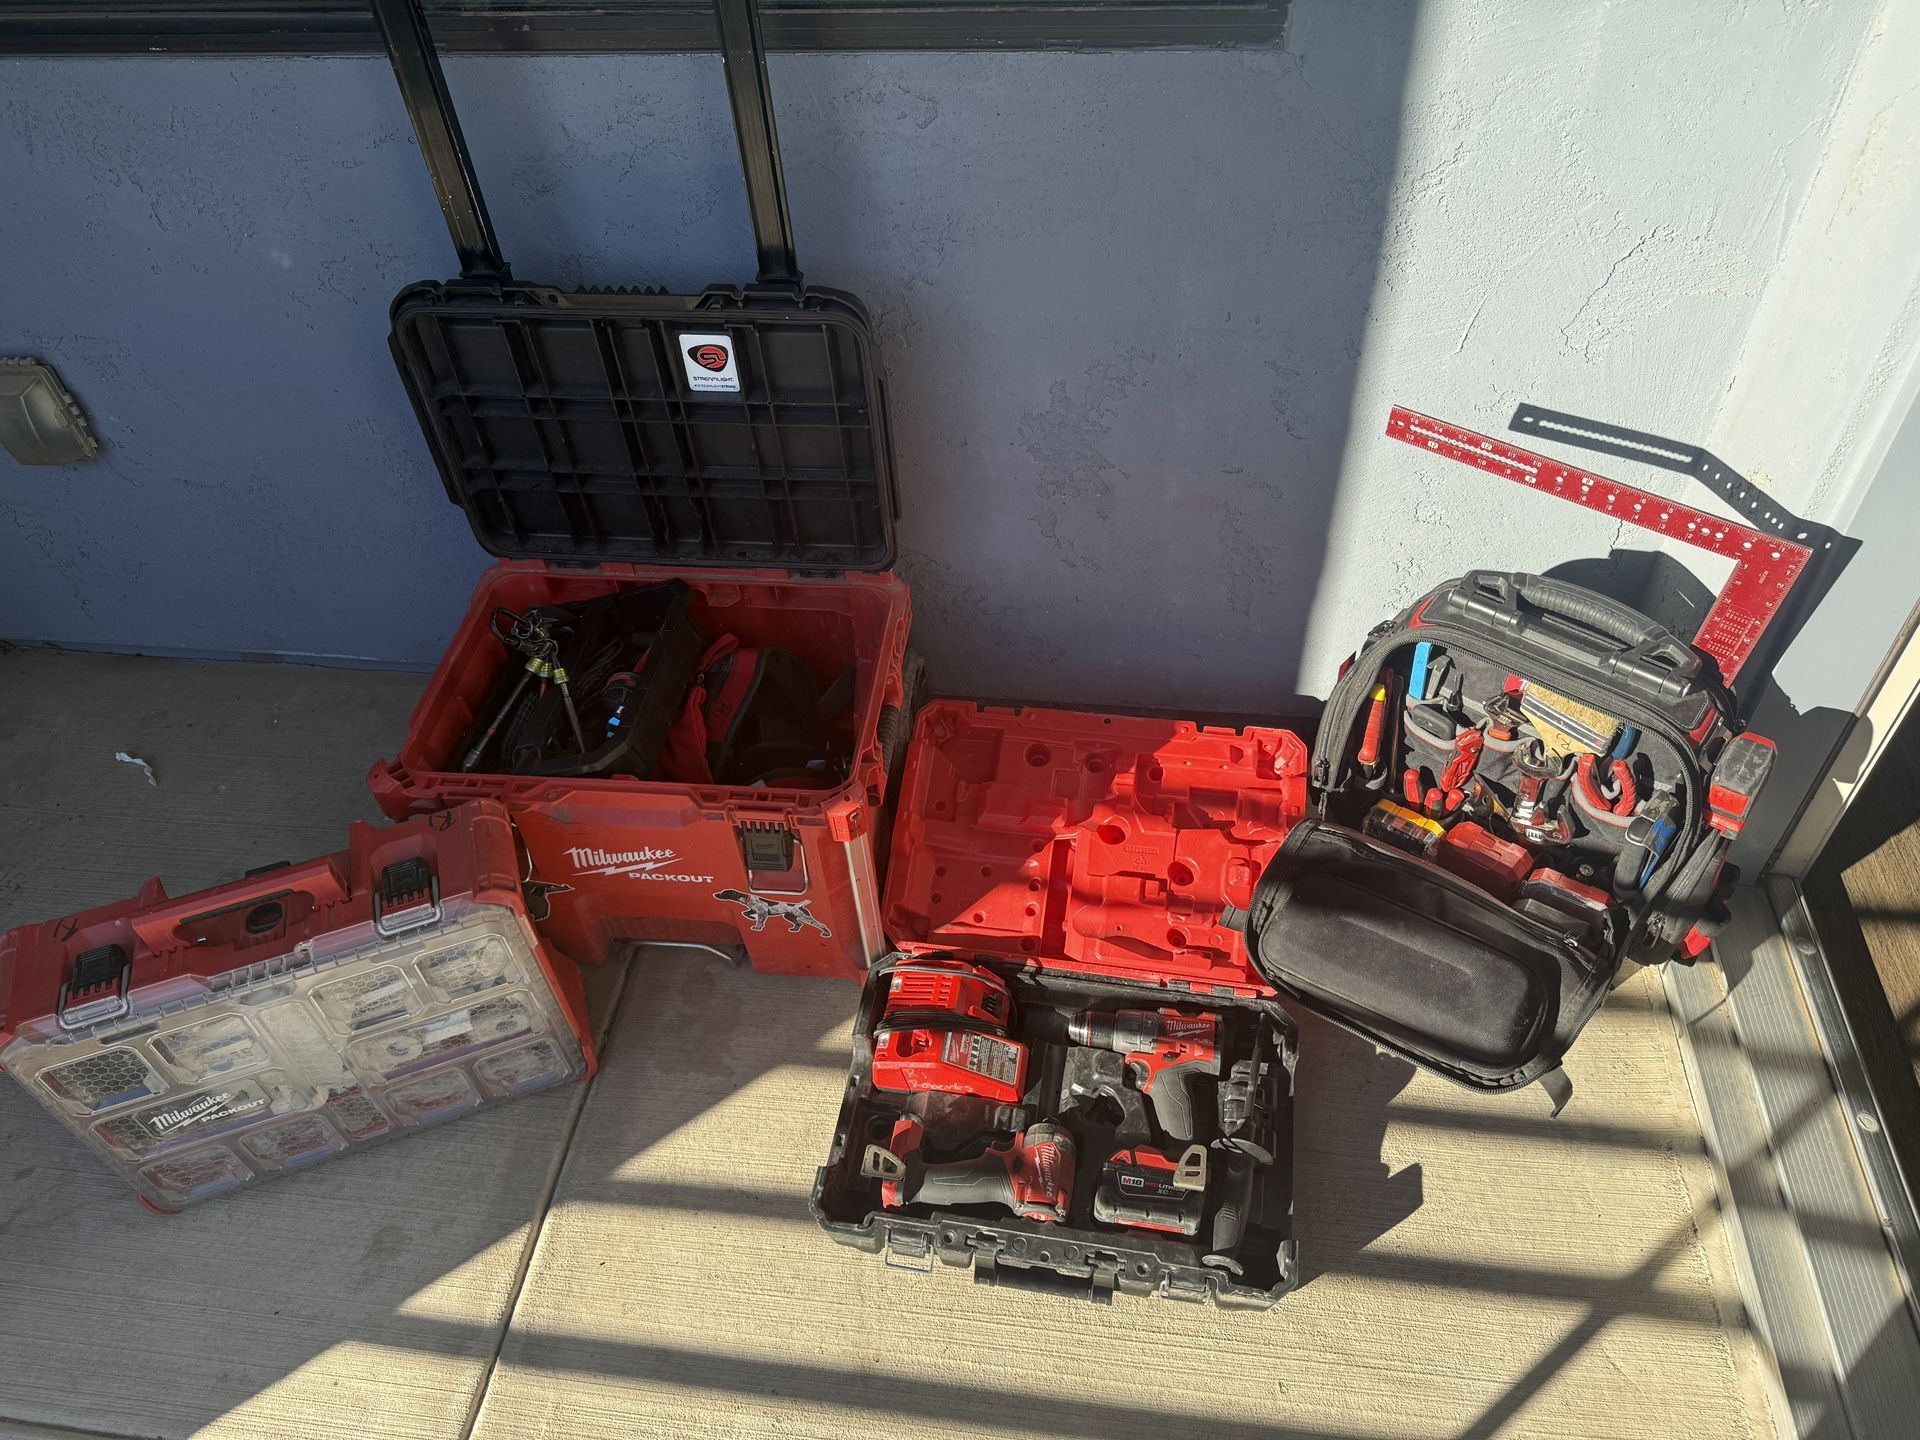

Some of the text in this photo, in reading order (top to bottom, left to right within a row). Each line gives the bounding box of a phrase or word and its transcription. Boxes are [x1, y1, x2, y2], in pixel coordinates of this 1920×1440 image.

[562, 847, 676, 869] Milwaukee
[628, 872, 714, 883] PACKOUT
[1166, 1020, 1211, 1031] Milwaukee
[148, 1092, 232, 1130] Milwaukee
[201, 1099, 265, 1122] PACKOUT
[1040, 1143, 1056, 1198] Milwaukee
[1122, 1177, 1143, 1186] M18
